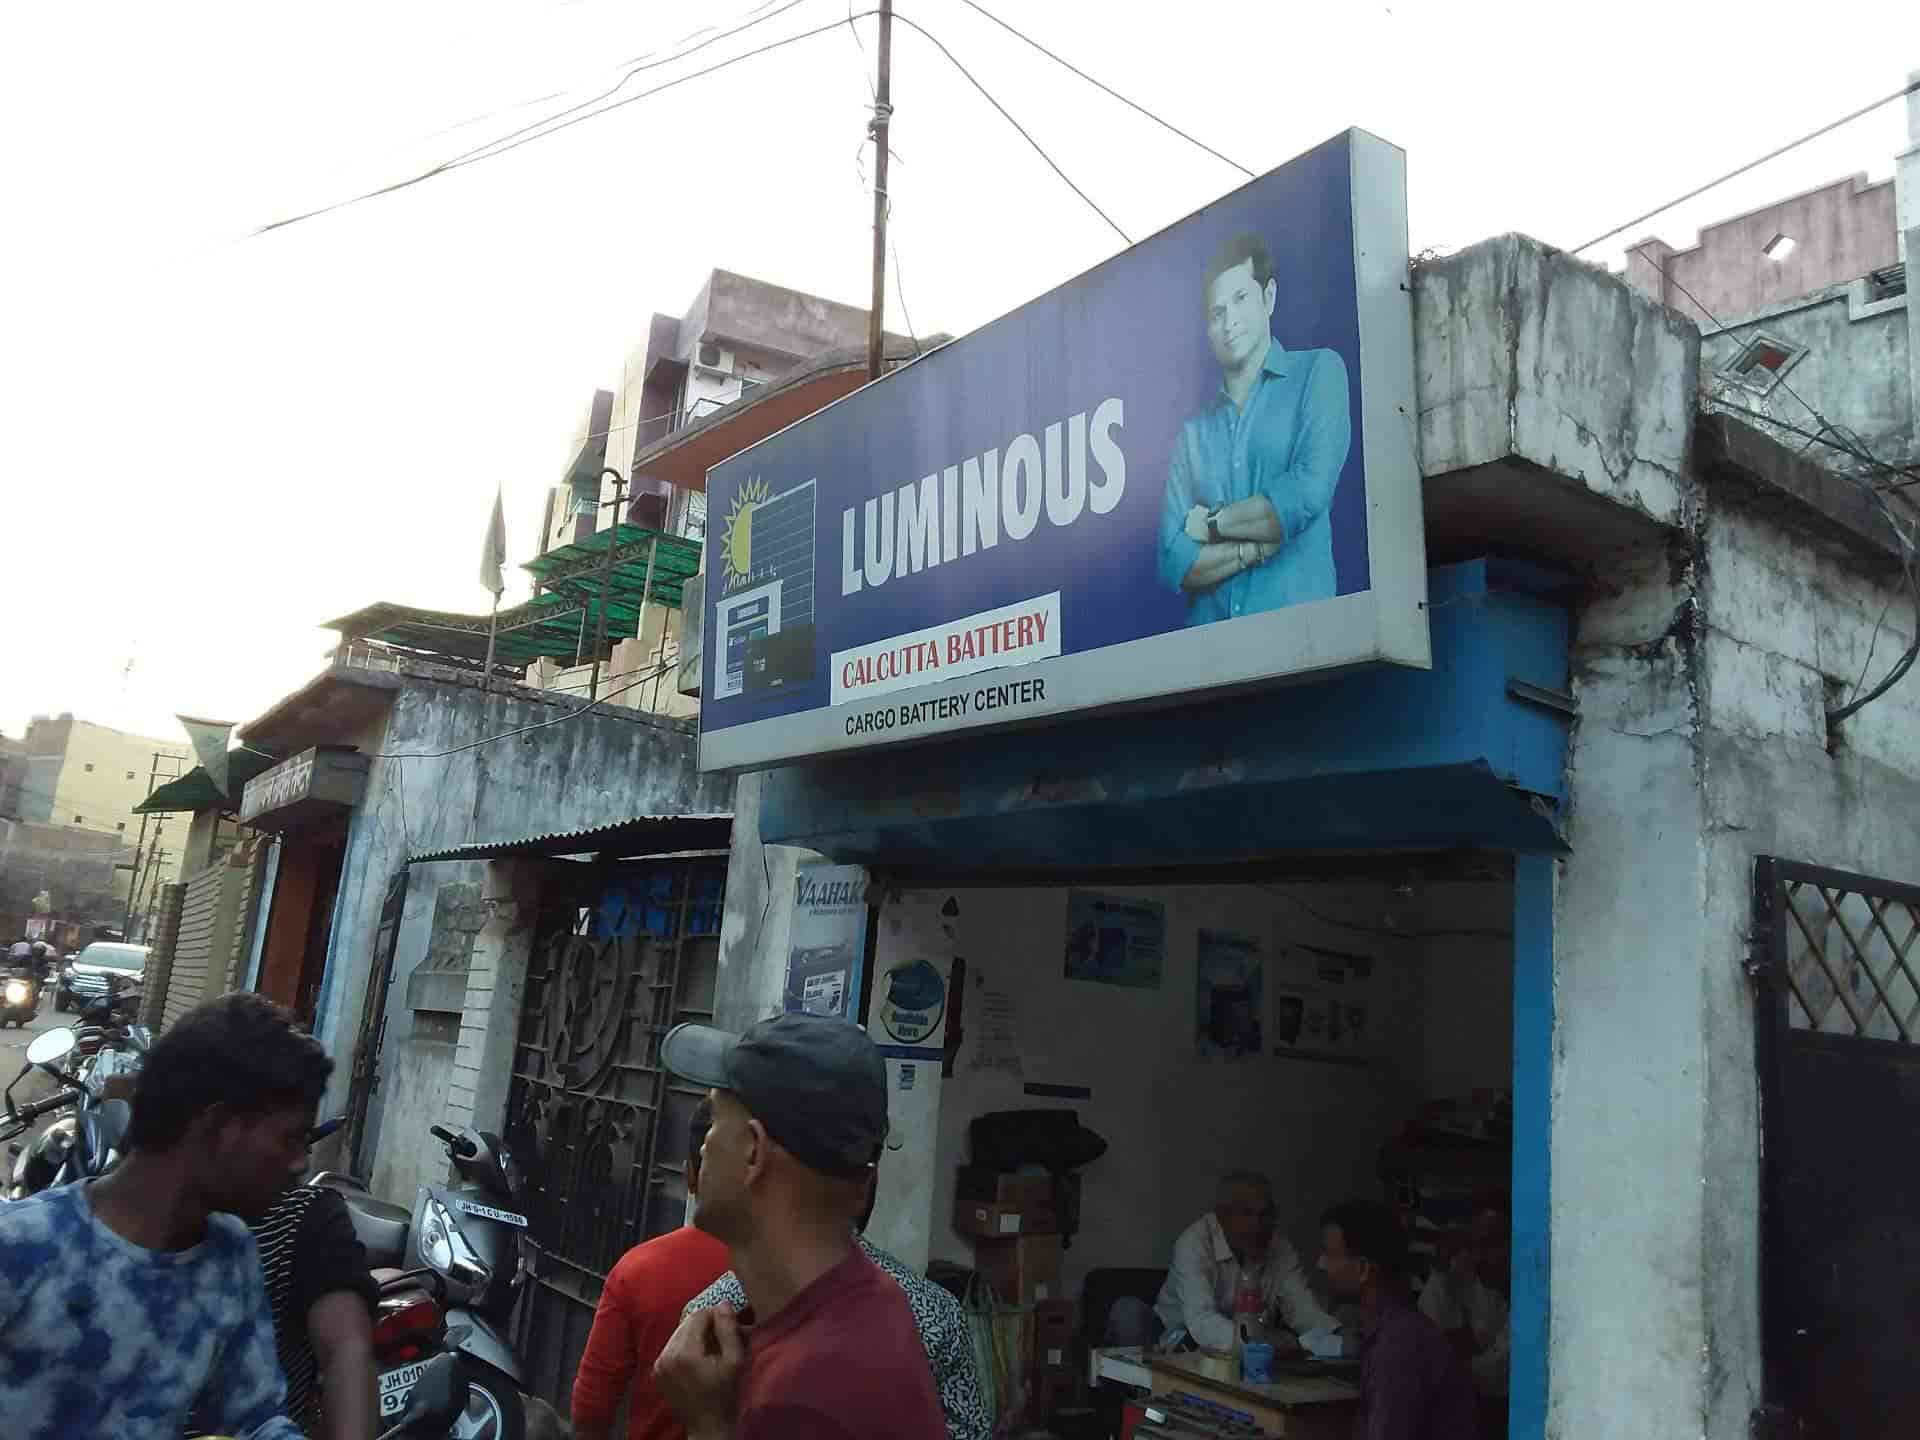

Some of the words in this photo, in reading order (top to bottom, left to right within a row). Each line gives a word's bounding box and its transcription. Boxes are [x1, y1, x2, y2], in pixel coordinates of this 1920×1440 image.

[842, 398, 1125, 596] LUMINOUS
[842, 639, 939, 689] CALCUTTA
[947, 609, 1049, 665] BATTERY
[845, 708, 896, 736] CARGO
[900, 693, 970, 726] BATTERY
[974, 678, 1046, 712] CENTER
